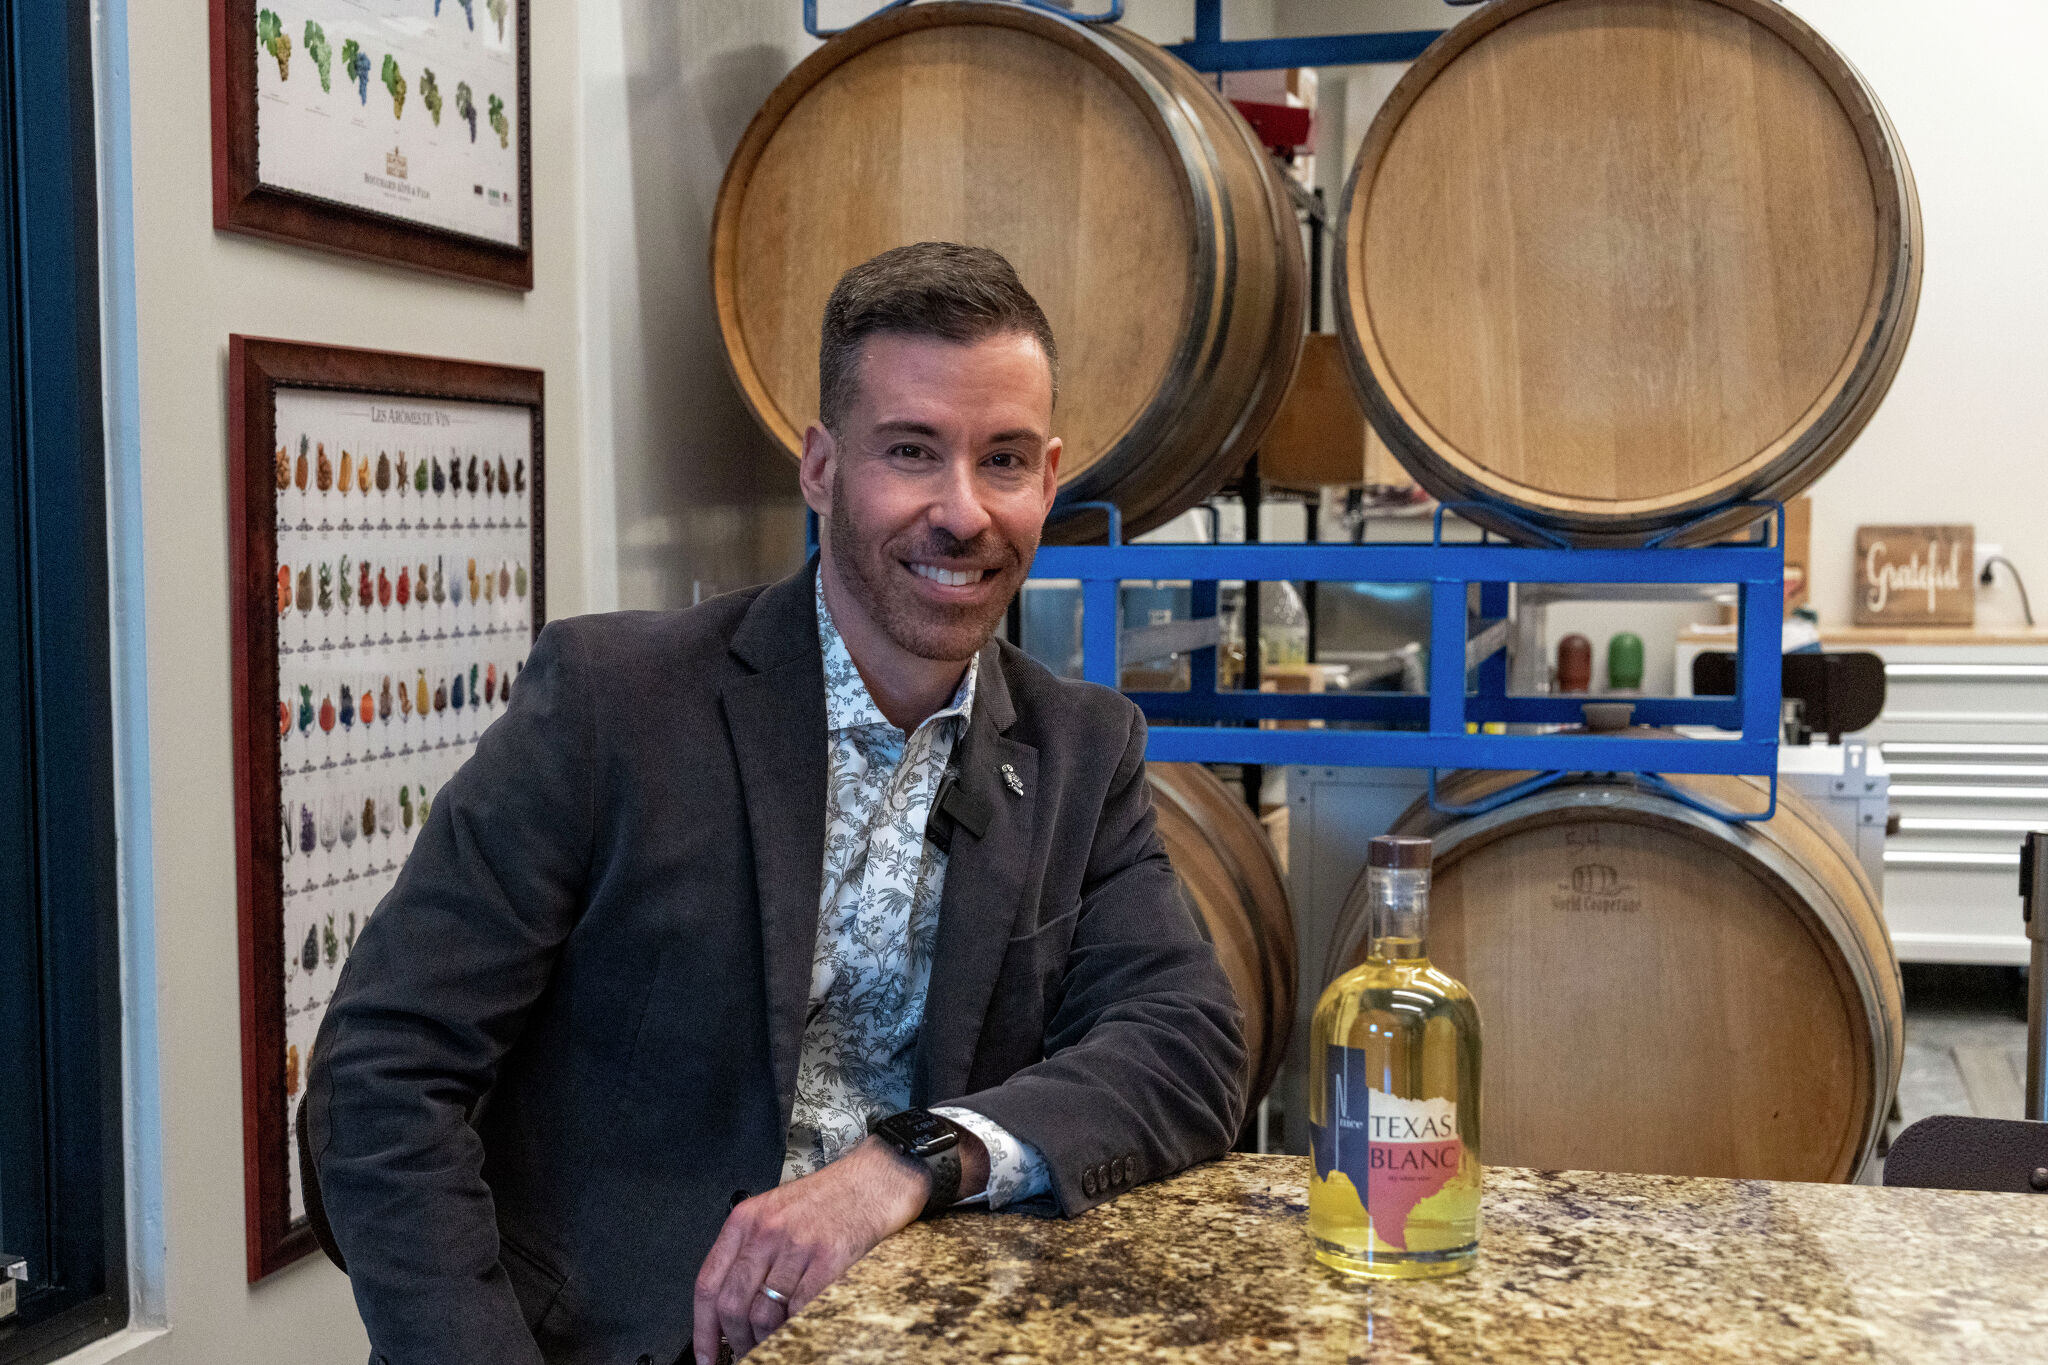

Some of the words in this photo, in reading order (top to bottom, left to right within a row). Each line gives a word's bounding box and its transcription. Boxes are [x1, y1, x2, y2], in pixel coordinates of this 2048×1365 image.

[1866, 540, 1961, 614] Grateful
[1370, 1114, 1452, 1139] TEXAS
[1371, 1146, 1457, 1170] BLANC
